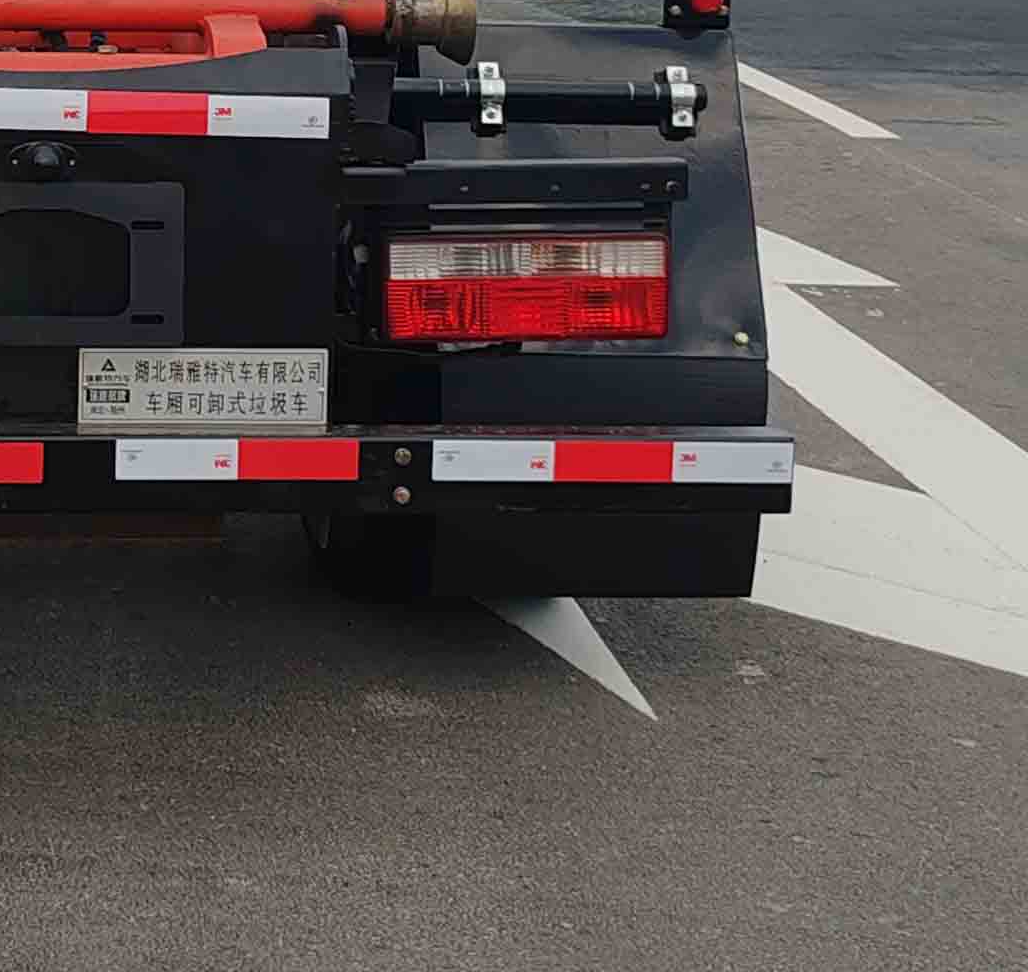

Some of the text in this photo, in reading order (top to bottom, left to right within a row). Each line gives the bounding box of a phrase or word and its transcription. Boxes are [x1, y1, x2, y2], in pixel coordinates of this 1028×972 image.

[214, 107, 232, 117] 3M
[134, 359, 322, 385] 湖北瑞雅特汽车有限公司
[145, 390, 309, 415] 车厢可卸式垃圾车
